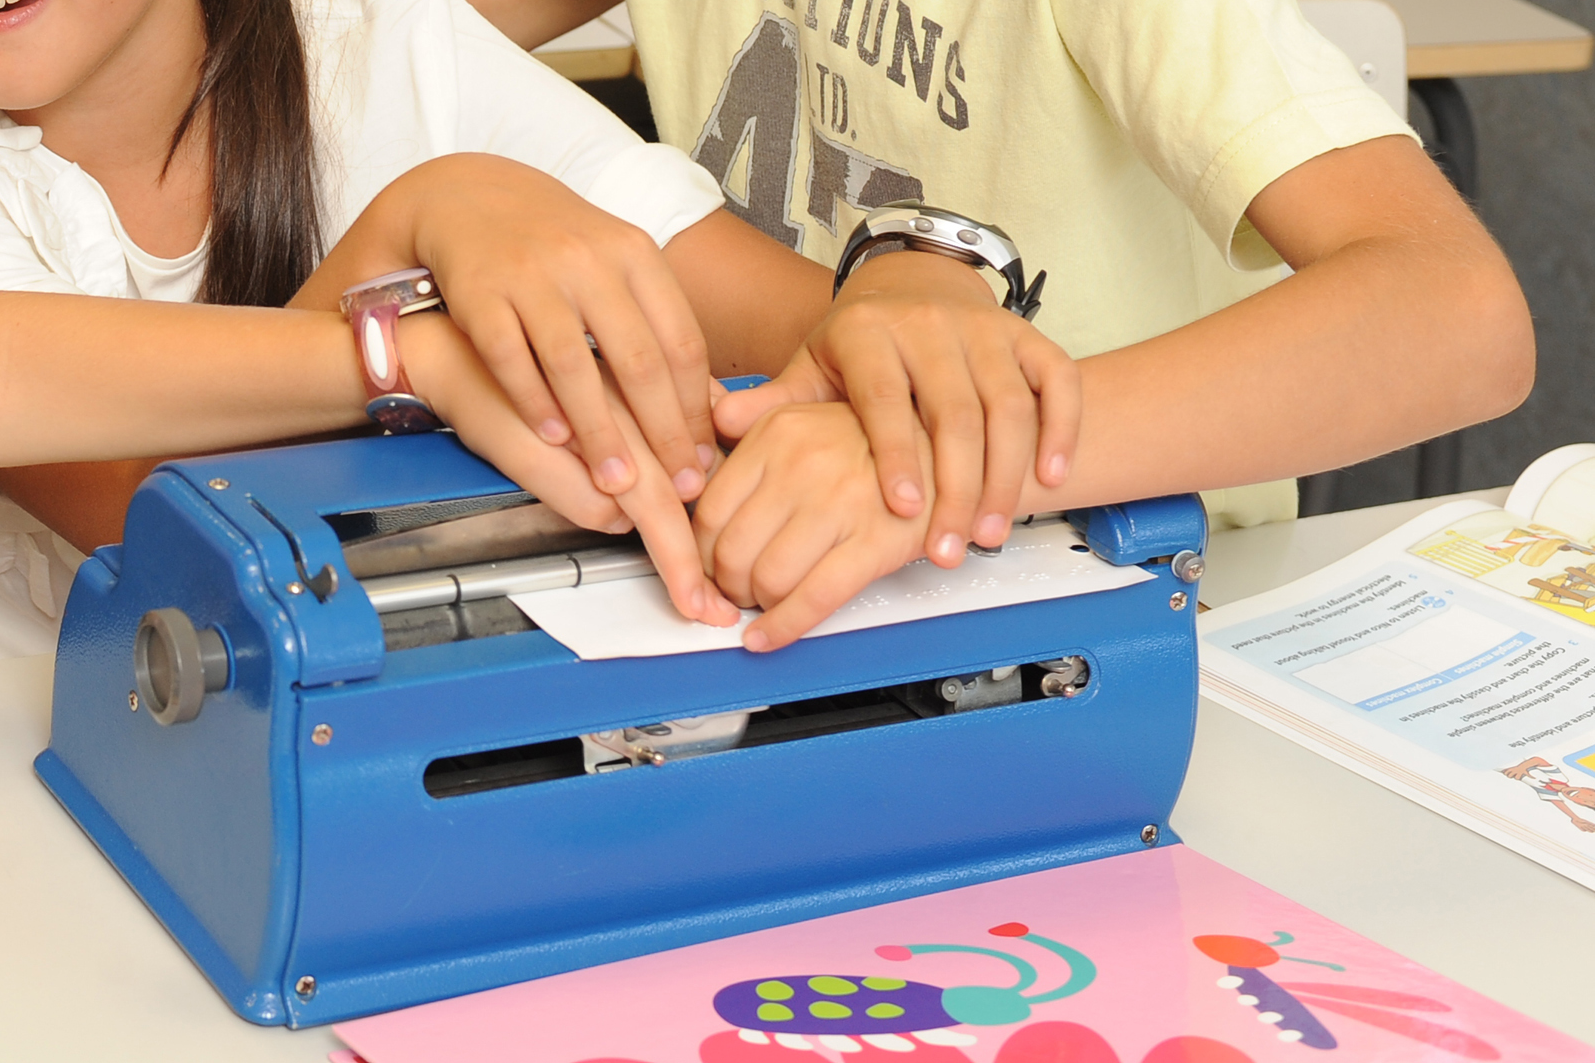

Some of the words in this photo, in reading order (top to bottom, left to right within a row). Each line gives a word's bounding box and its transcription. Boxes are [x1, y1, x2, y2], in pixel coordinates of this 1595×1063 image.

[805, 53, 857, 141] TD.
[1504, 649, 1536, 667] picture.
[1541, 647, 1566, 660] Copy
[1506, 668, 1529, 680] chart
[1551, 657, 1590, 681] machines
[1460, 686, 1492, 700] classify
[1500, 688, 1536, 705] complex
[1408, 703, 1448, 719] machines
[1509, 693, 1555, 714] differences
[1460, 703, 1503, 722] machines?
[1474, 712, 1514, 727] between
[1447, 725, 1476, 737] simple
[1522, 729, 1559, 743] identify
